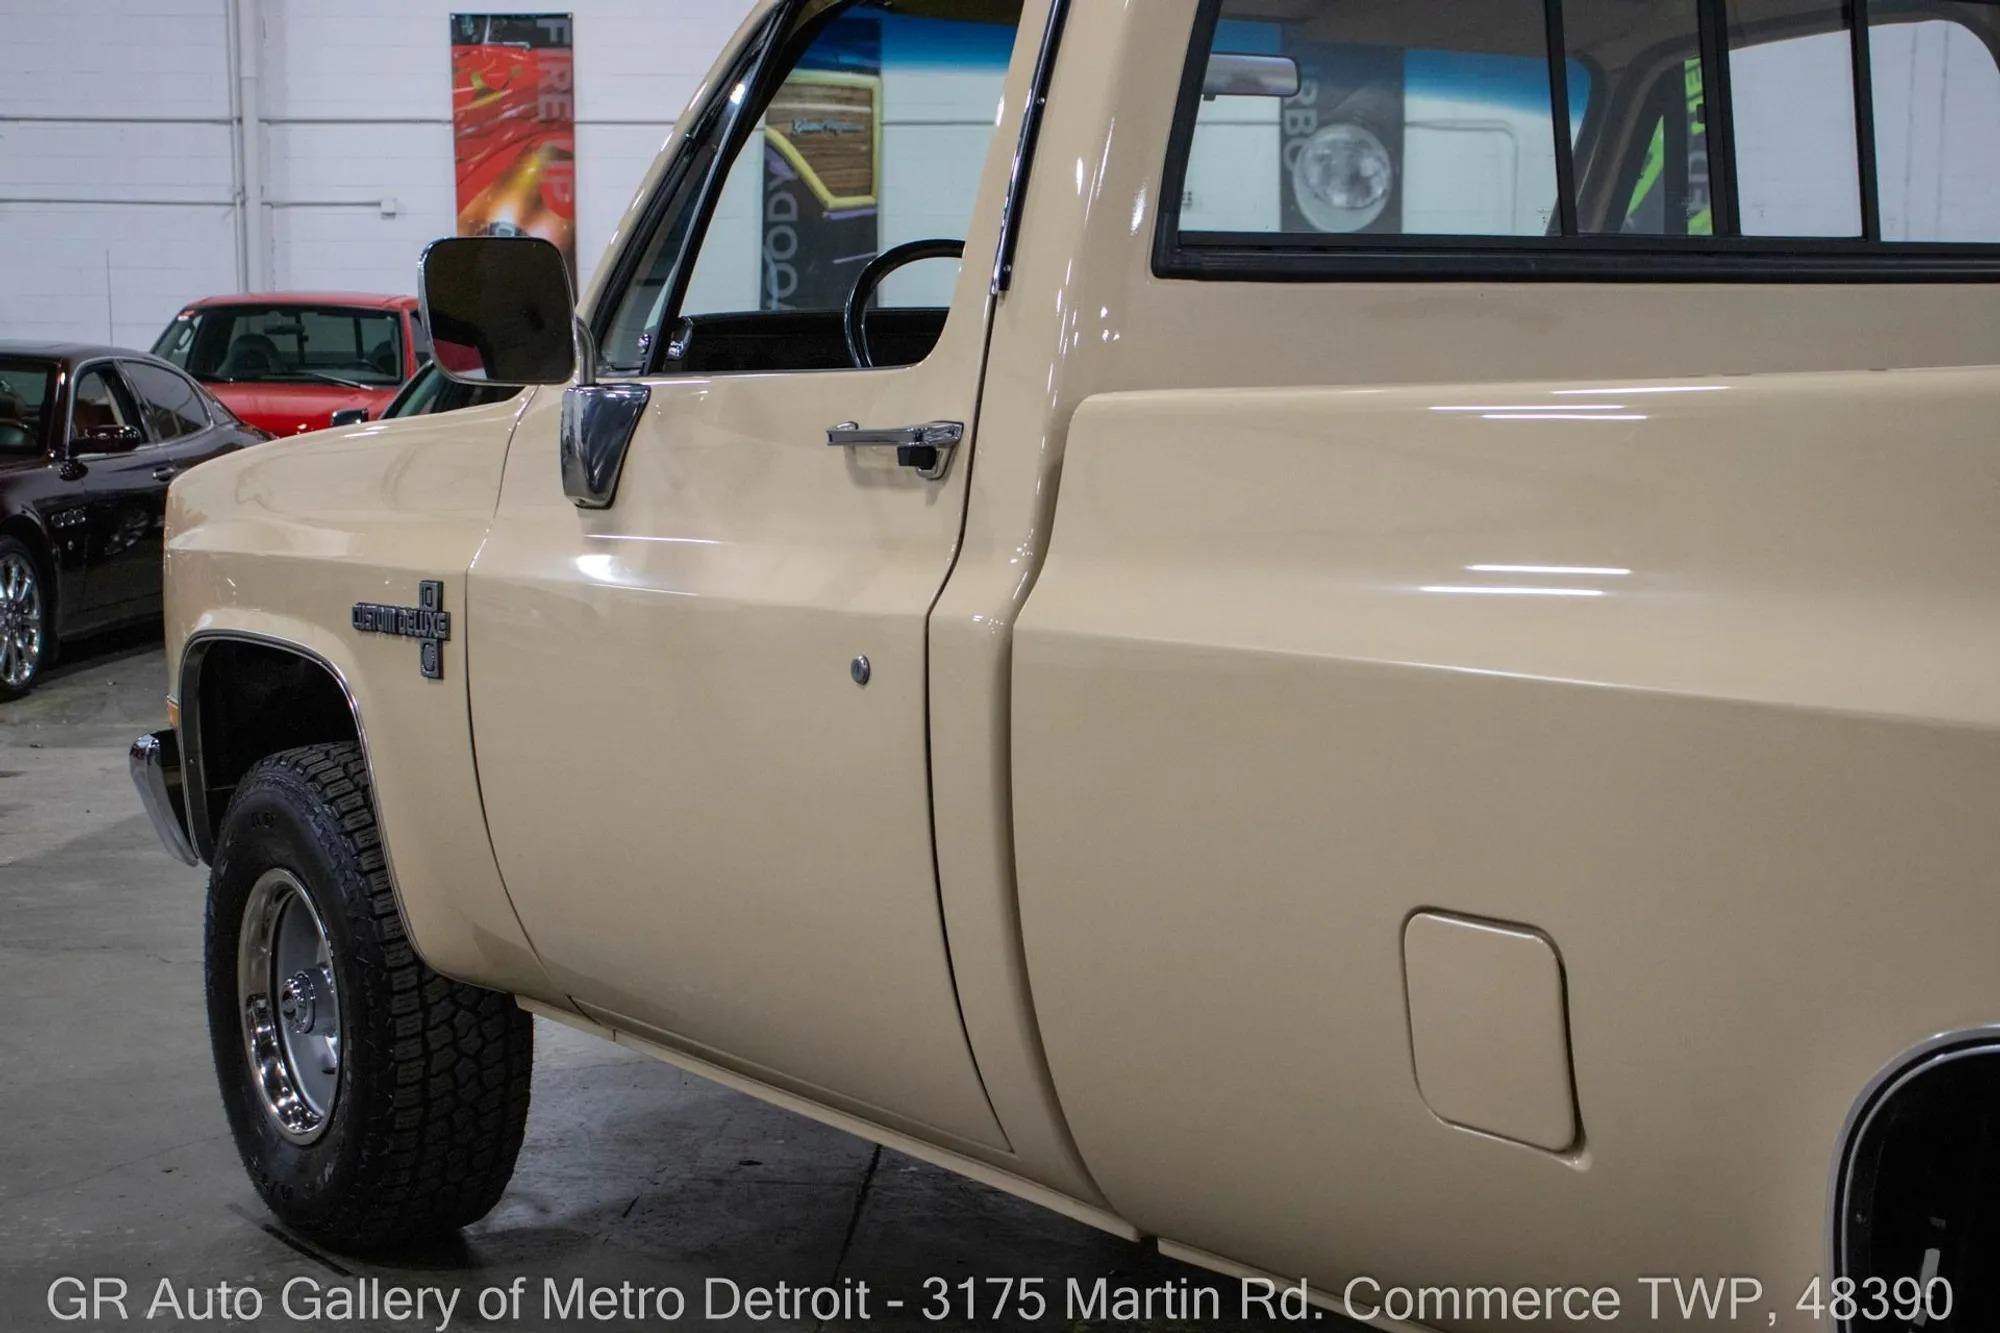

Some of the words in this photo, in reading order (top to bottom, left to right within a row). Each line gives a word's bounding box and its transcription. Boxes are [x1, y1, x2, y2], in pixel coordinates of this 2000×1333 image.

[536, 18, 572, 121] FIRE
[541, 139, 574, 201] UP
[352, 603, 396, 633] CUSTOM
[398, 608, 448, 640] DELUXE
